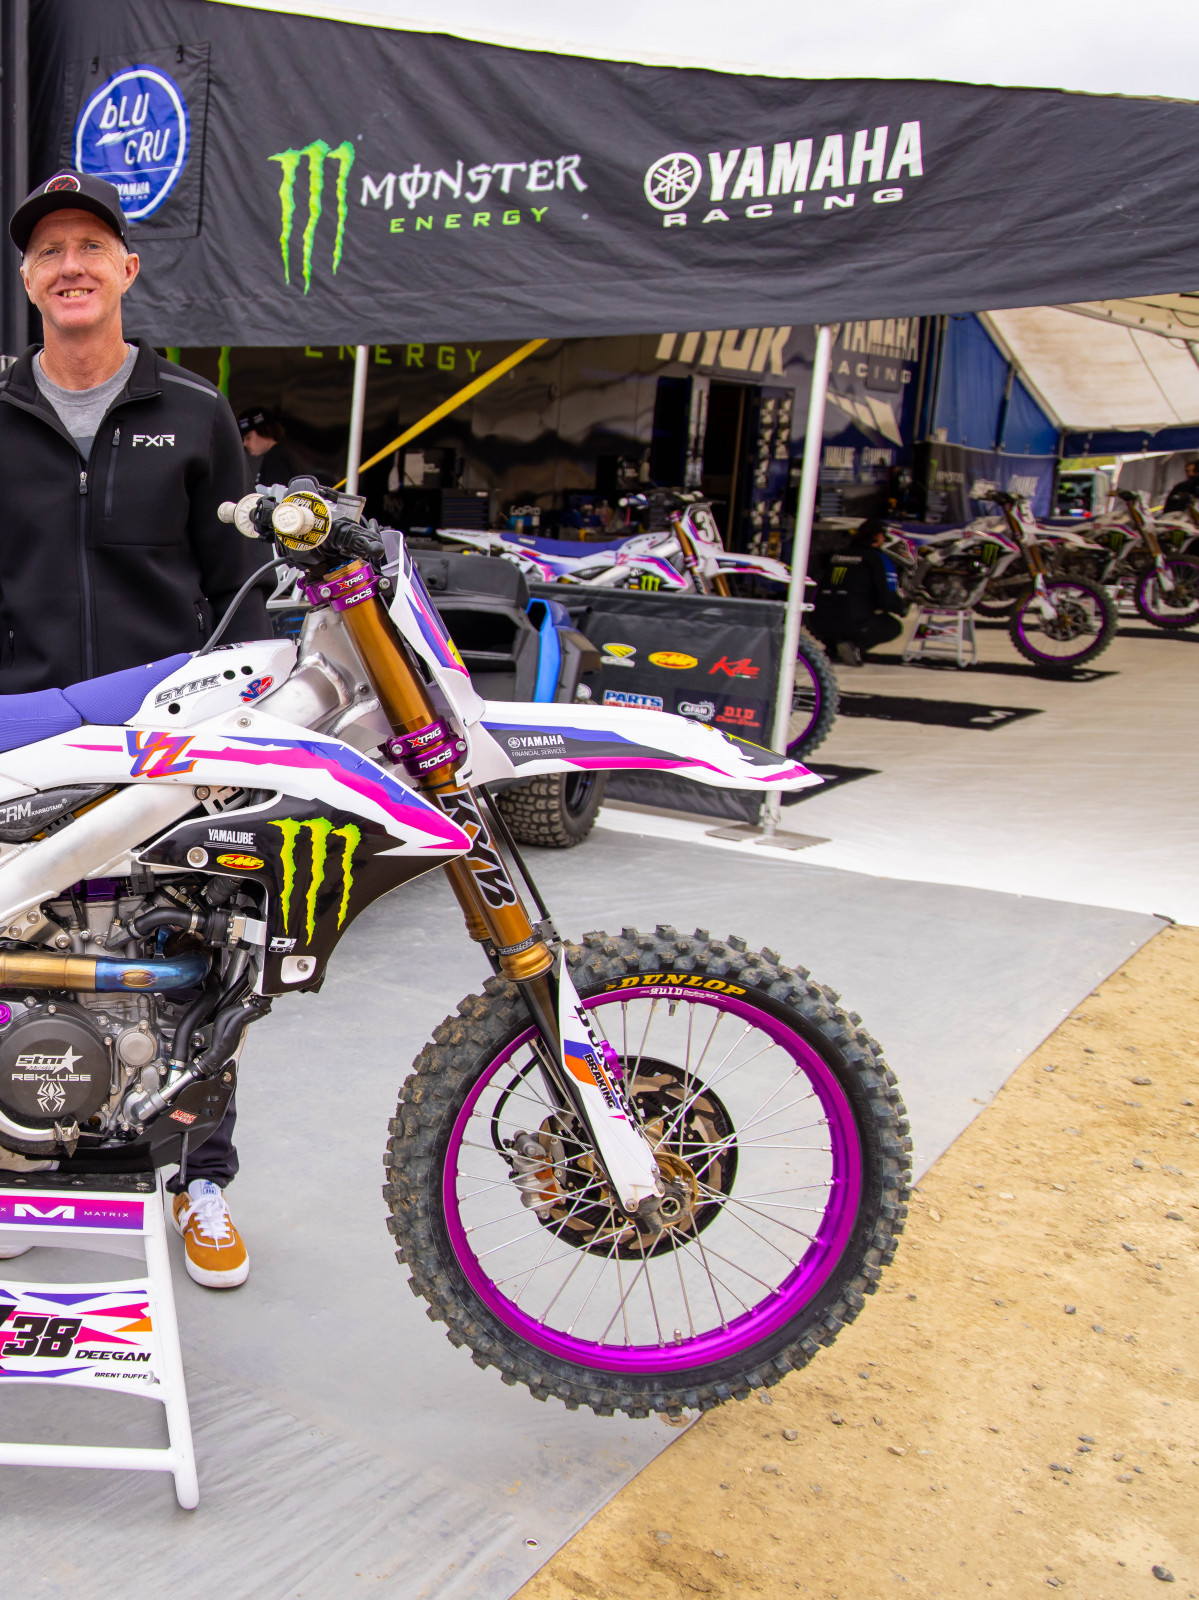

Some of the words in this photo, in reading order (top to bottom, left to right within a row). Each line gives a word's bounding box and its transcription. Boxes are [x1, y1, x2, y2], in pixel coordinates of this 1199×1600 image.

[707, 120, 924, 202] YAMAHA
[662, 187, 904, 228] RACING
[389, 206, 550, 234] ENERGY
[829, 357, 912, 385] ACING
[132, 434, 176, 447] FXR
[510, 505, 541, 516] GoPro
[336, 573, 365, 591] XTRIG
[345, 588, 373, 605] ROCS
[154, 672, 222, 705] GYTR
[239, 679, 262, 699] VP
[604, 690, 663, 708] PARTS
[684, 704, 708, 715] AFAM
[406, 727, 442, 749] XTRIG
[519, 734, 565, 747] YAMAHA
[125, 729, 198, 779] YZ
[418, 749, 453, 771] ROCS
[511, 749, 541, 757] FINANCIAL
[540, 748, 567, 756] SERVICES
[208, 828, 255, 845] YAMALUBE
[217, 855, 265, 868] FMF
[617, 973, 747, 997] DUNLOP
[11, 1073, 92, 1082] REKLUSE
[583, 1052, 617, 1110] BRAKING
[83, 1210, 129, 1218] MATRIX
[2, 1315, 82, 1358] 38
[74, 1349, 151, 1363] DEEGAN
[94, 1371, 122, 1379] BRENT
[121, 1373, 149, 1381] DUFFE
